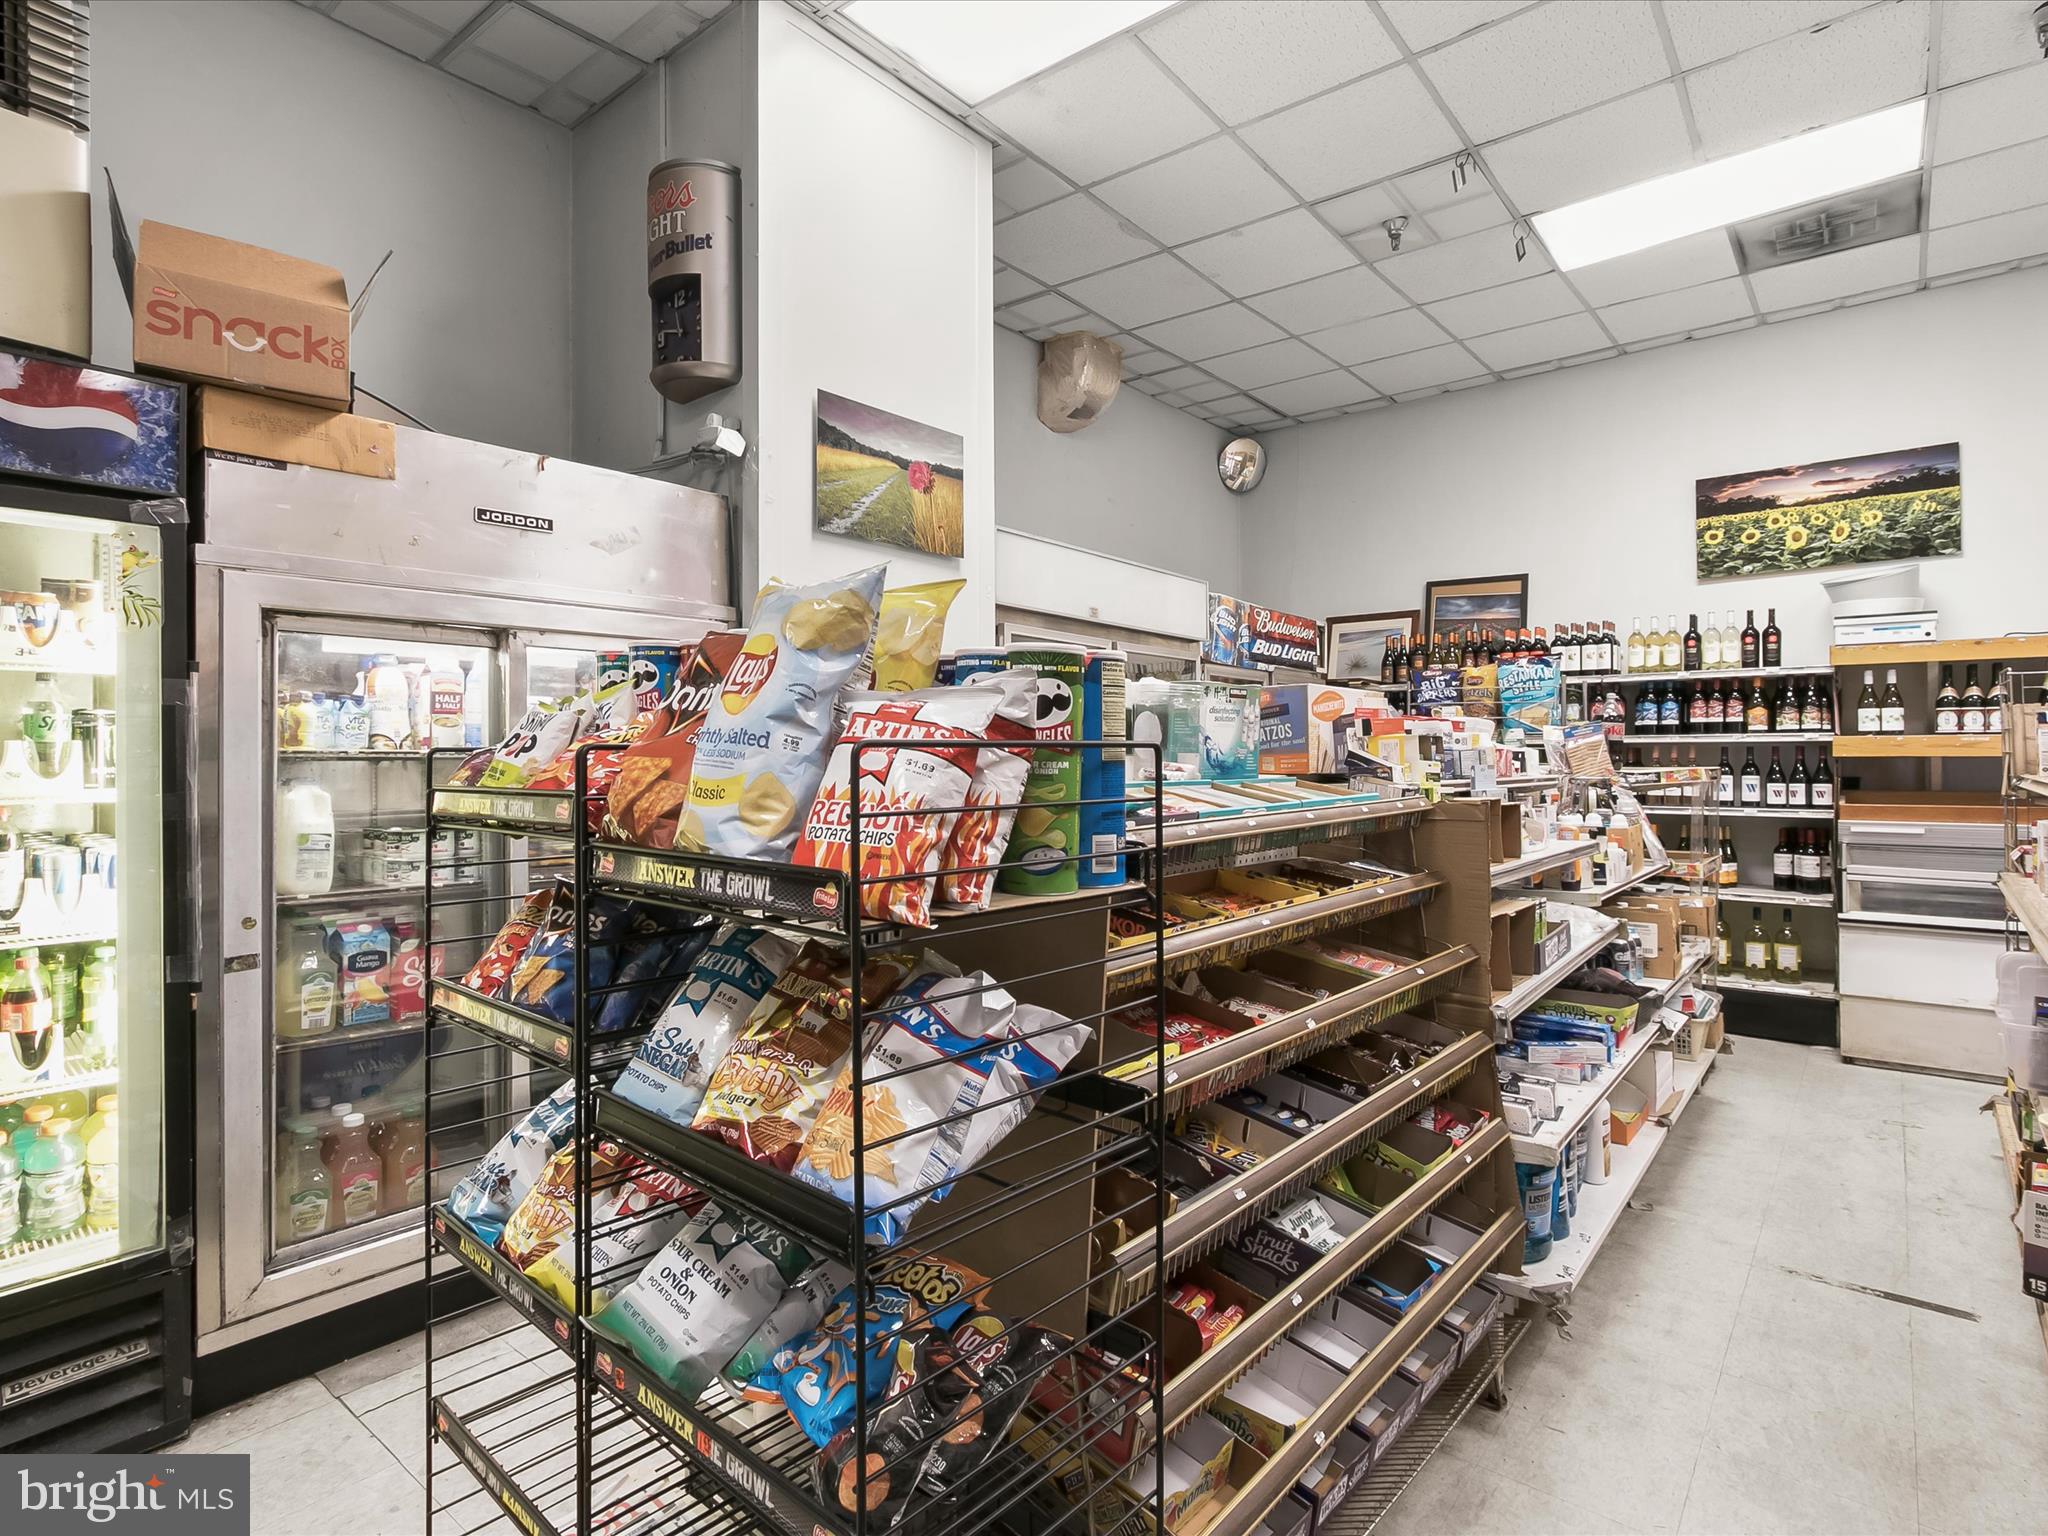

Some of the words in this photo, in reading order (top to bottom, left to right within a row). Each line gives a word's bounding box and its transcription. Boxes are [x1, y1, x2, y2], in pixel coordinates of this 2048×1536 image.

[650, 180, 698, 214] ors
[649, 210, 687, 242] GHT
[673, 289, 686, 309] 12
[145, 299, 329, 366] snack
[331, 336, 346, 370] BOX
[481, 511, 549, 529] JORDON
[1254, 608, 1315, 640] Budweiser
[1251, 639, 1283, 657] BUD
[1281, 643, 1316, 663] LIGHT
[723, 654, 776, 697] Lay's
[1421, 676, 1446, 690] BIG
[1512, 680, 1542, 695] STYLE
[435, 694, 461, 703] HALF
[442, 702, 461, 710] HALF
[636, 692, 660, 711] GLES
[1208, 705, 1241, 717] disinfecting
[783, 737, 800, 747] 4.99
[1260, 723, 1293, 742] ATZOS
[497, 733, 538, 758] POP
[1041, 761, 1069, 769] CREAM
[458, 798, 491, 815] ANSWER
[493, 799, 508, 816] THE
[508, 799, 535, 818] GROWL
[858, 829, 896, 845] CHIPS
[639, 862, 695, 888] ANSWER
[700, 869, 723, 893] THE
[725, 872, 775, 901] GROWL
[355, 959, 380, 969] Mango
[717, 990, 738, 1005] $1.69
[1555, 1003, 1585, 1015] SOUR
[459, 1000, 492, 1028] ANSWER
[492, 1010, 507, 1028] THE
[507, 1015, 535, 1043] GROWL
[875, 1044, 903, 1065] $1.69
[624, 1066, 650, 1085] POTATO
[648, 1079, 668, 1094] CHIPS
[963, 1080, 985, 1097] Nutri
[1340, 1083, 1356, 1097] 36
[1288, 1208, 1315, 1231] Junior
[1256, 1229, 1295, 1255] Fruit
[1241, 1236, 1299, 1272] Snacks
[458, 1236, 493, 1277] ANSWER
[493, 1264, 509, 1286] THE
[509, 1278, 535, 1313] GROWL
[669, 1238, 694, 1264] SOUR
[692, 1255, 732, 1299] CREAM
[680, 1267, 694, 1280] &
[729, 1262, 750, 1286] $1.69
[660, 1266, 698, 1304] ONION
[2028, 1278, 2047, 1292] 15
[622, 1300, 634, 1313] NET
[648, 1275, 672, 1302] POTATO
[670, 1298, 691, 1320] CHIPS
[638, 1382, 694, 1445] ANSWER
[931, 1455, 946, 1470] 230
[725, 1450, 775, 1508] GROWL
